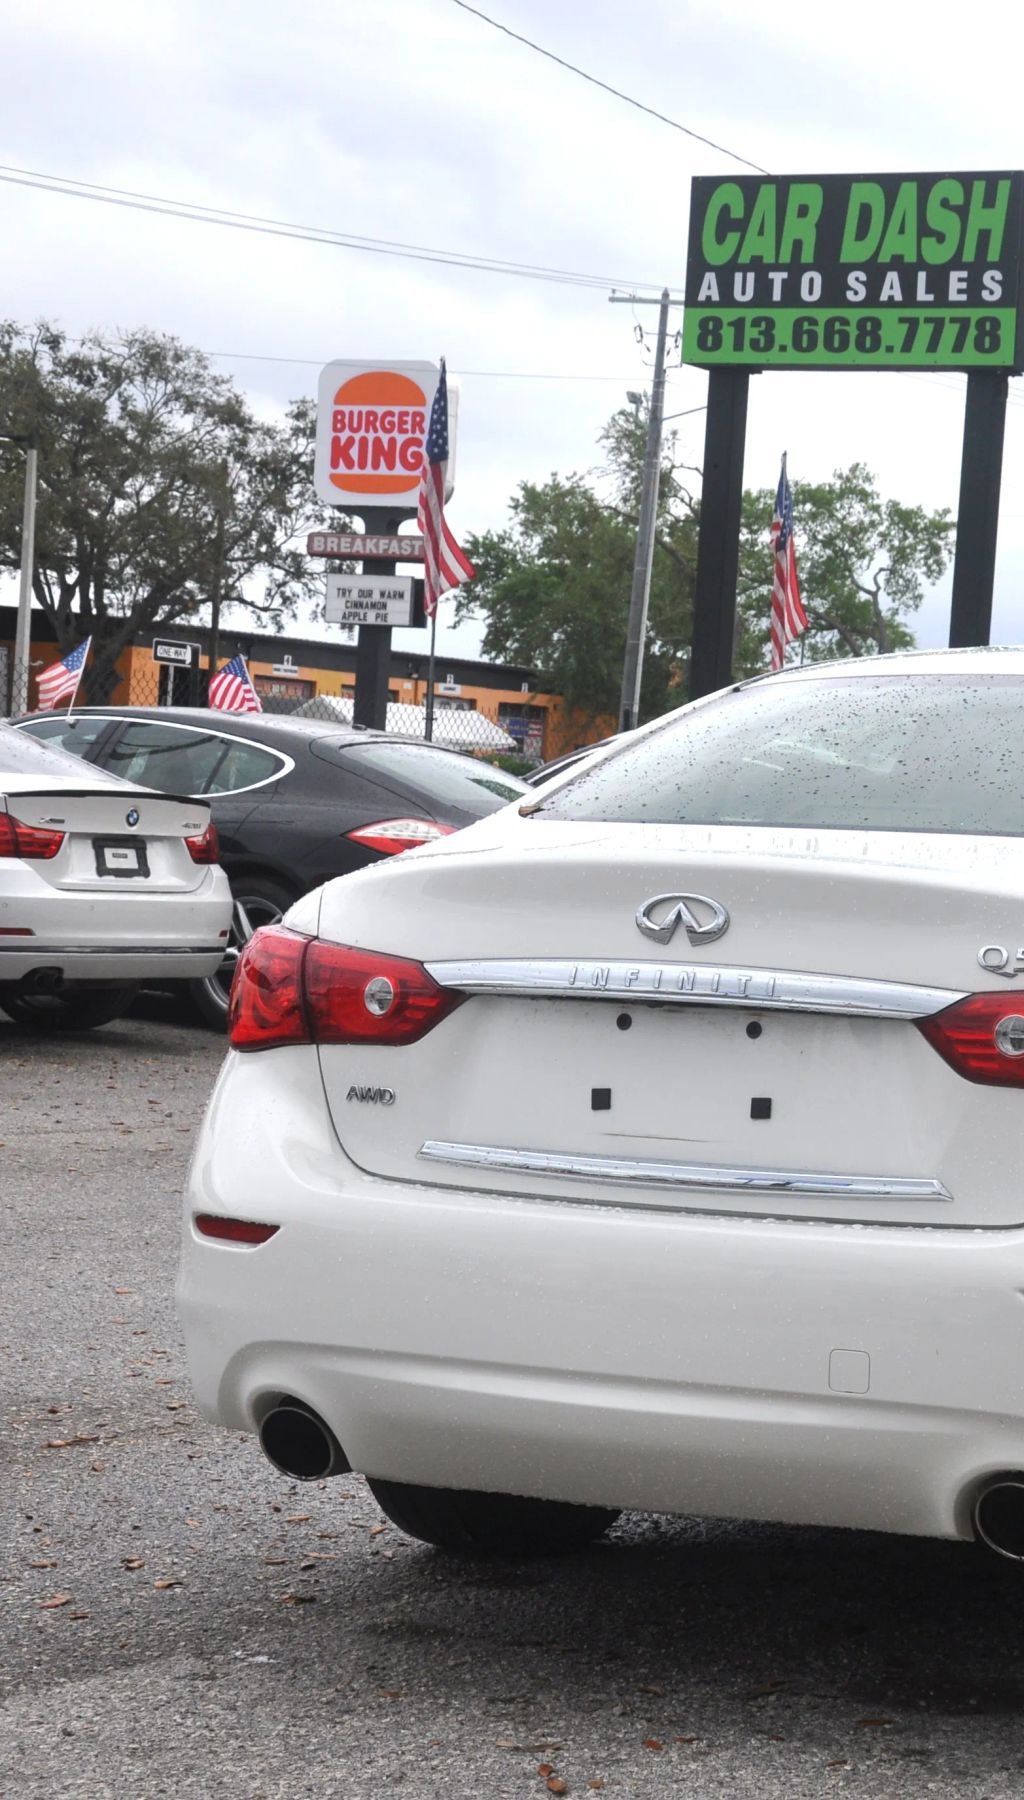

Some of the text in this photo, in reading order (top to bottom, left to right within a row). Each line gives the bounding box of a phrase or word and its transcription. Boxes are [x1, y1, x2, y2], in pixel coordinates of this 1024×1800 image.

[702, 179, 1012, 266] CAR DASH
[697, 269, 1004, 303] AUTO SALES
[696, 315, 1002, 354] 813.668.7778
[332, 409, 426, 435] BURGER
[330, 434, 424, 472] KING
[313, 536, 424, 556] BREAKFAST
[336, 587, 405, 601] TRY OUR WARM
[344, 600, 388, 611] CINNAMON
[341, 611, 389, 624] APPLE PIE
[159, 646, 187, 658] ONE WAY
[568, 966, 777, 997] INFINITI
[345, 1084, 396, 1105] AWD
